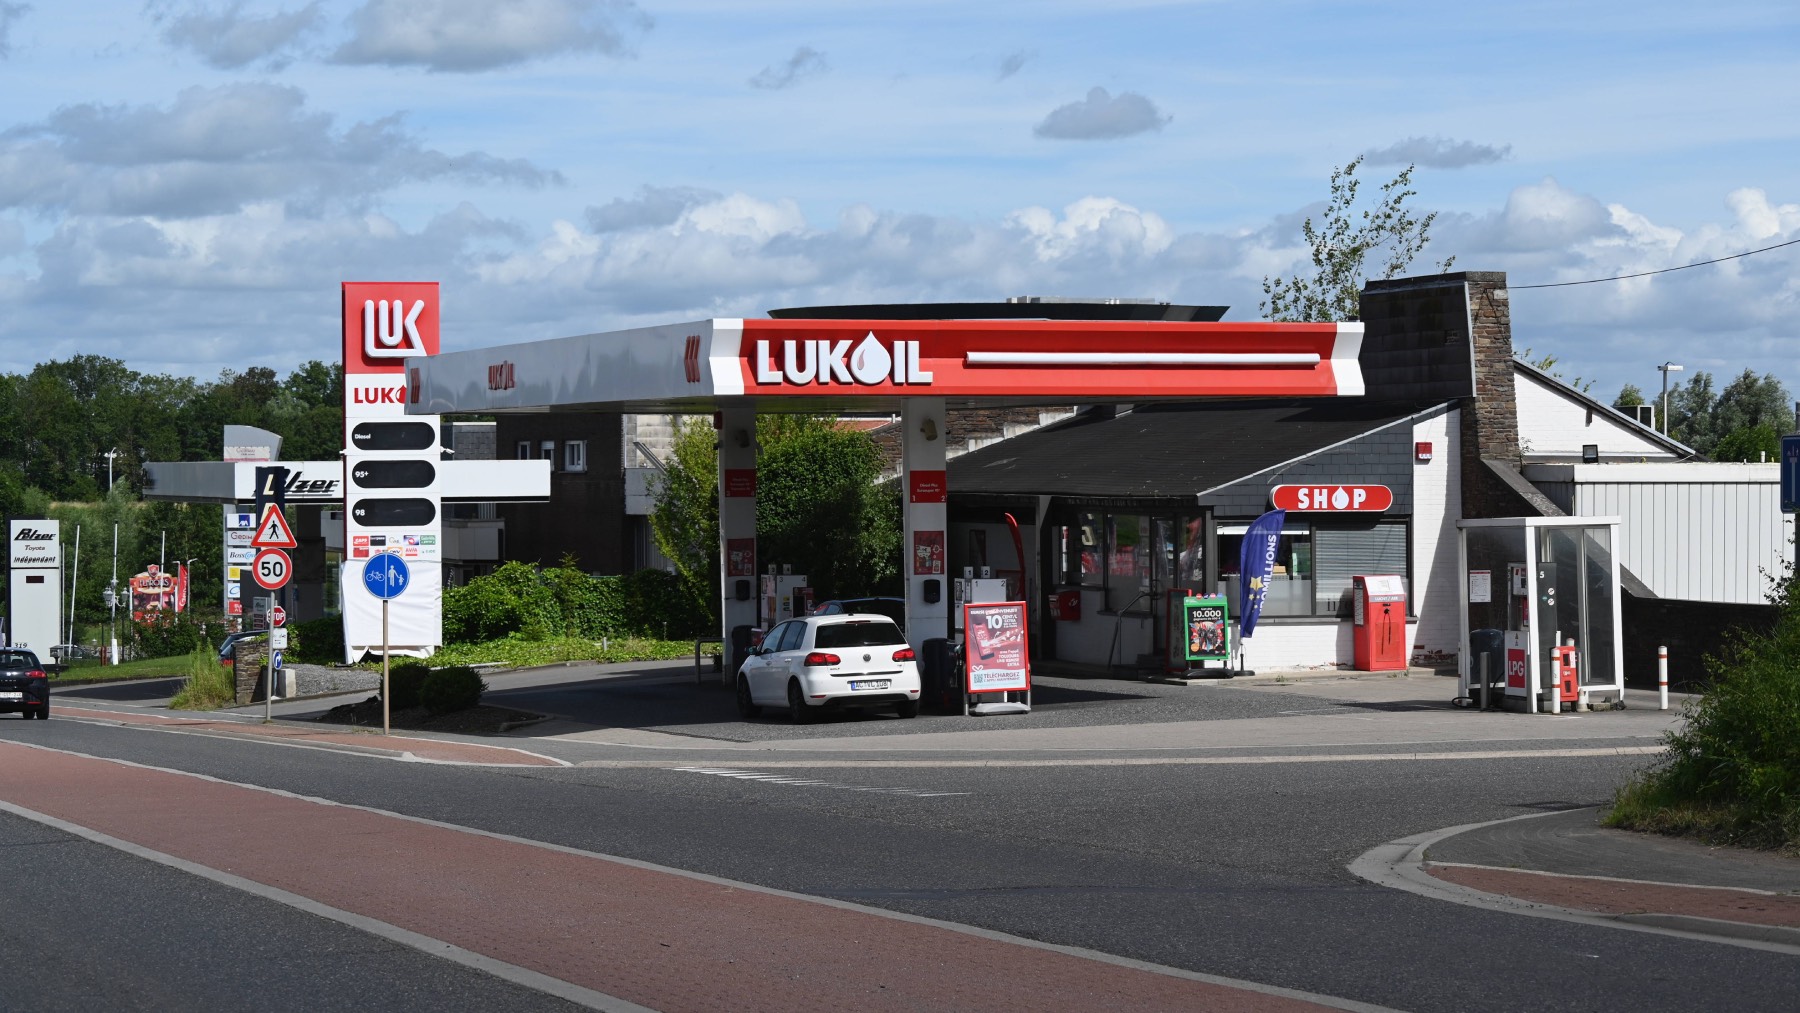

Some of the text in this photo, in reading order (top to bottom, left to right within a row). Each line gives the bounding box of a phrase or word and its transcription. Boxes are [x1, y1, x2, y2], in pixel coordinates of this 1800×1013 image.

[365, 300, 427, 358] LUK
[756, 331, 933, 384] LUKOIL
[1297, 486, 1367, 510] SHOP
[25, 544, 46, 552] Toyota
[261, 561, 283, 577] 50
[1540, 571, 1545, 579] 5
[1000, 579, 1006, 587] 2
[1192, 610, 1222, 618] 10.000
[985, 615, 1003, 629] 10
[1508, 660, 1524, 677] LPG
